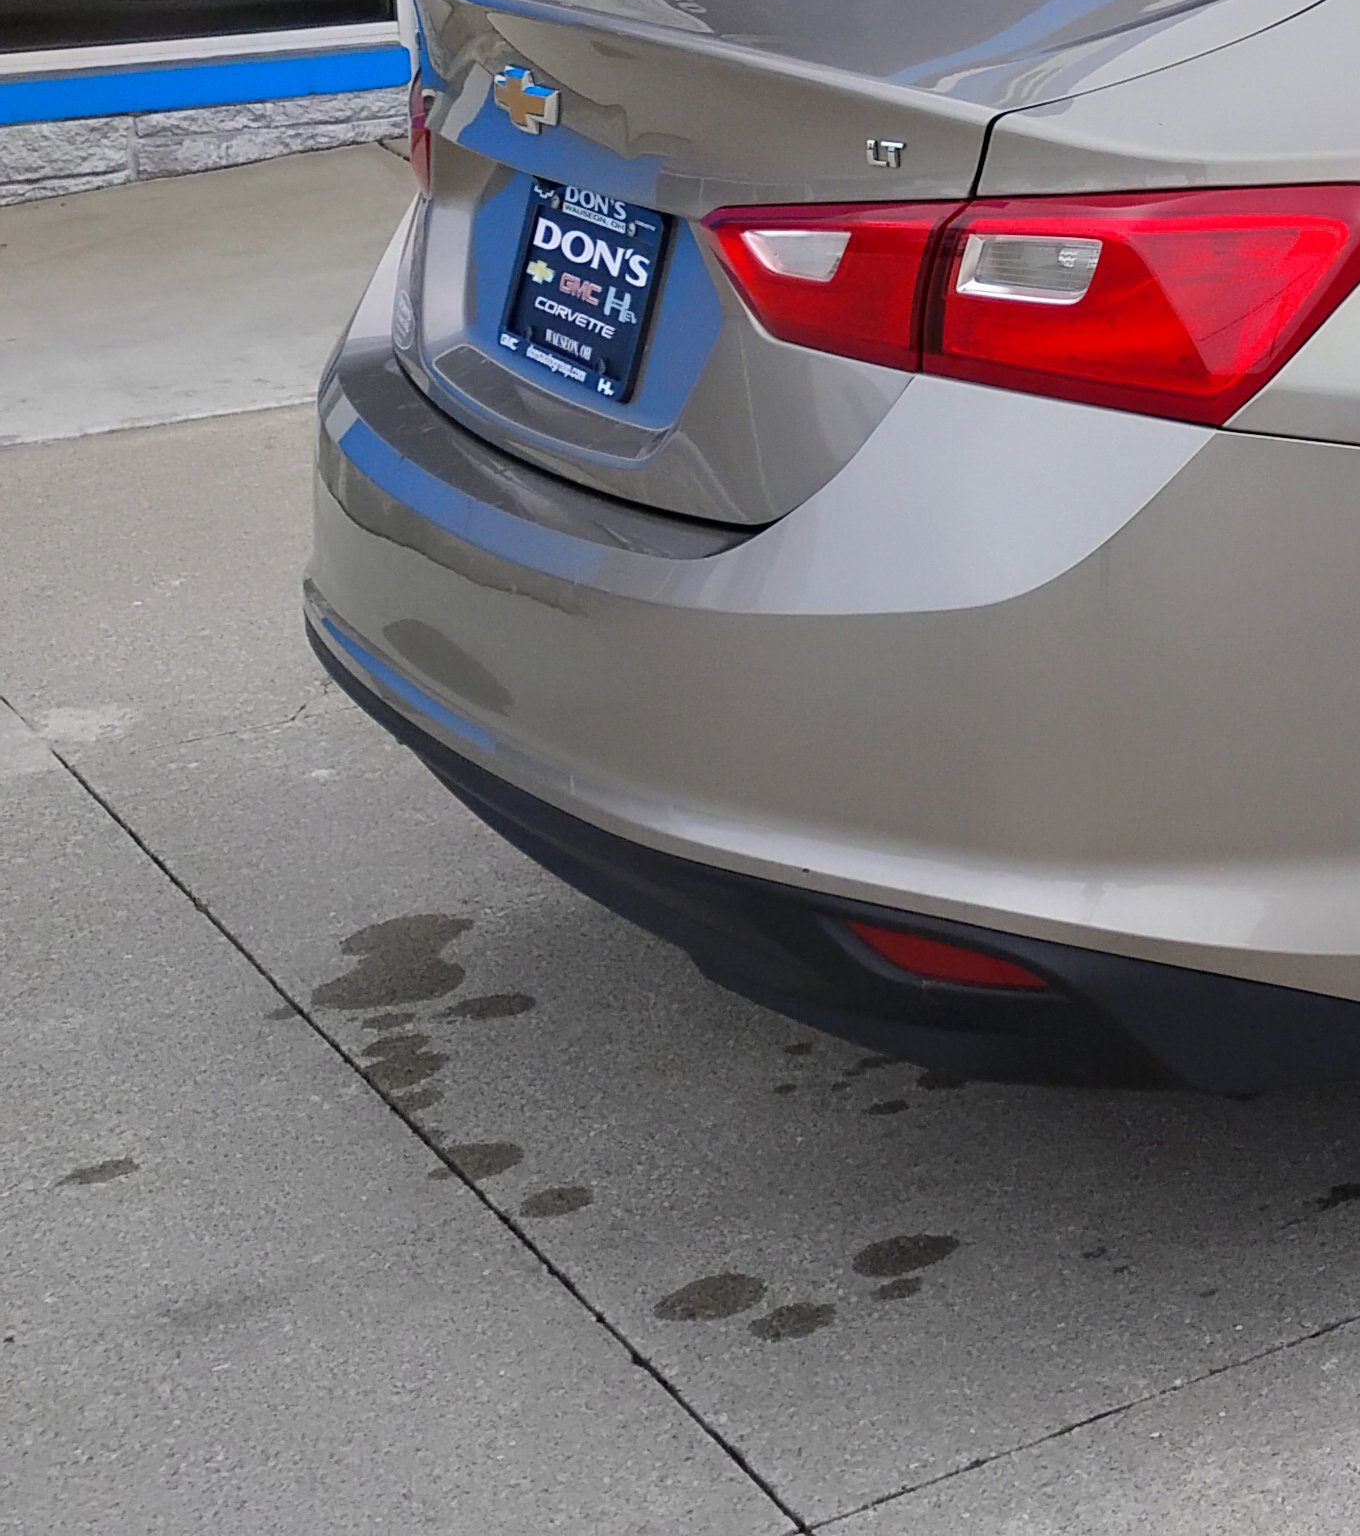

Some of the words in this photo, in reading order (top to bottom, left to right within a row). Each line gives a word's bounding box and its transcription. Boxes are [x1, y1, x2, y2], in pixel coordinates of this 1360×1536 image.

[866, 139, 905, 168] LT
[564, 186, 627, 221] DON'S
[533, 216, 650, 287] DON'S
[560, 272, 602, 306] GMC
[534, 296, 616, 340] CORVETTE
